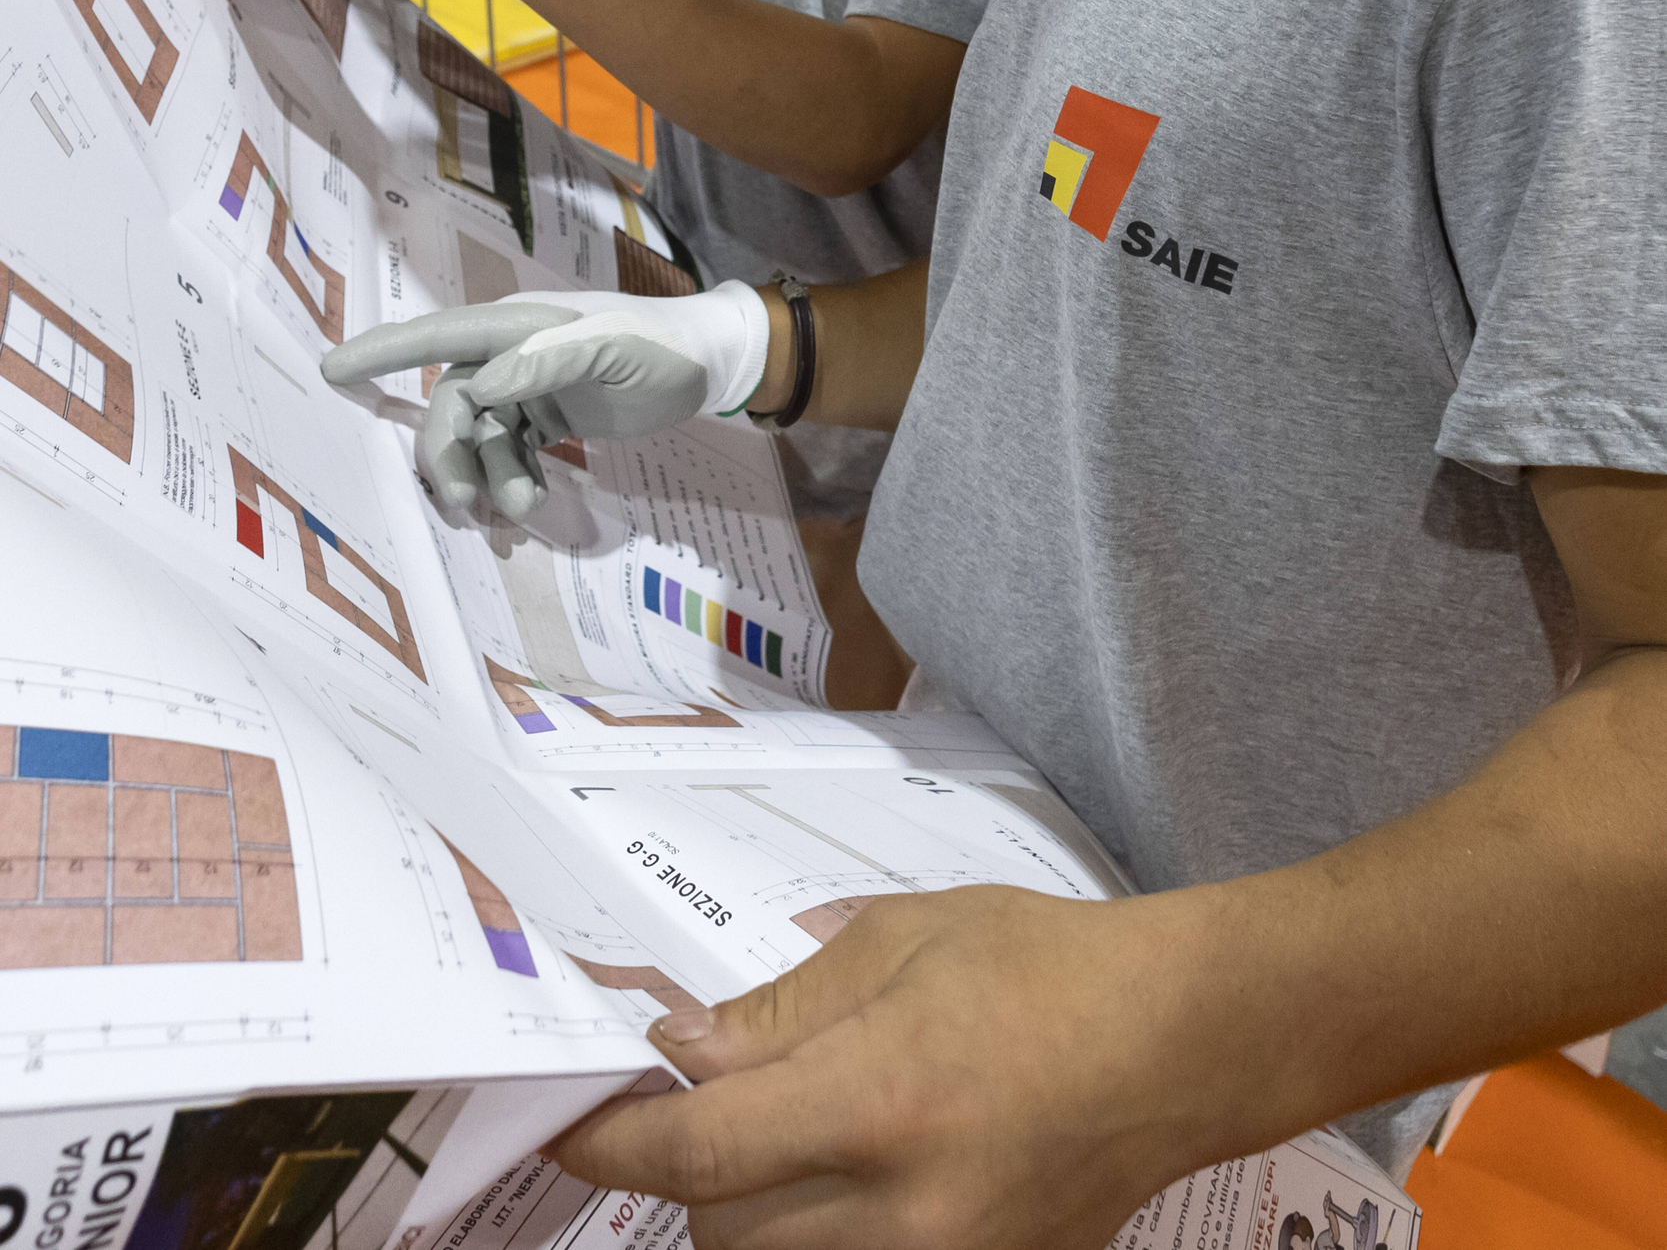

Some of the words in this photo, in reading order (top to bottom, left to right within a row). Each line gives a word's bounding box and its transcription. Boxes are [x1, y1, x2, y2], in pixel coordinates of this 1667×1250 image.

[1120, 220, 1240, 296] SAIE
[177, 272, 203, 305] 5
[624, 562, 635, 620] STANDARD
[569, 787, 618, 801] 7
[903, 776, 955, 795] 10
[69, 859, 83, 872] 12
[204, 861, 217, 875] 12
[626, 840, 660, 868] G-G
[656, 864, 733, 927] SEZIONE
[35, 1135, 92, 1250] GORIA
[73, 1124, 154, 1250] NIOR
[491, 1205, 515, 1229] I.T.T.
[509, 1155, 552, 1204] "NERVI-G
[1219, 1159, 1235, 1215] utilizz
[1264, 1160, 1277, 1194] DPI
[450, 1181, 503, 1249] ELABORATO
[645, 1200, 668, 1226] una
[1132, 1213, 1146, 1231] la
[1149, 1189, 1167, 1233] cazz
[1196, 1163, 1222, 1250] DOVRAN
[1222, 1190, 1240, 1250] assima
[1261, 1198, 1269, 1212] E
[1253, 1217, 1266, 1250] URE
